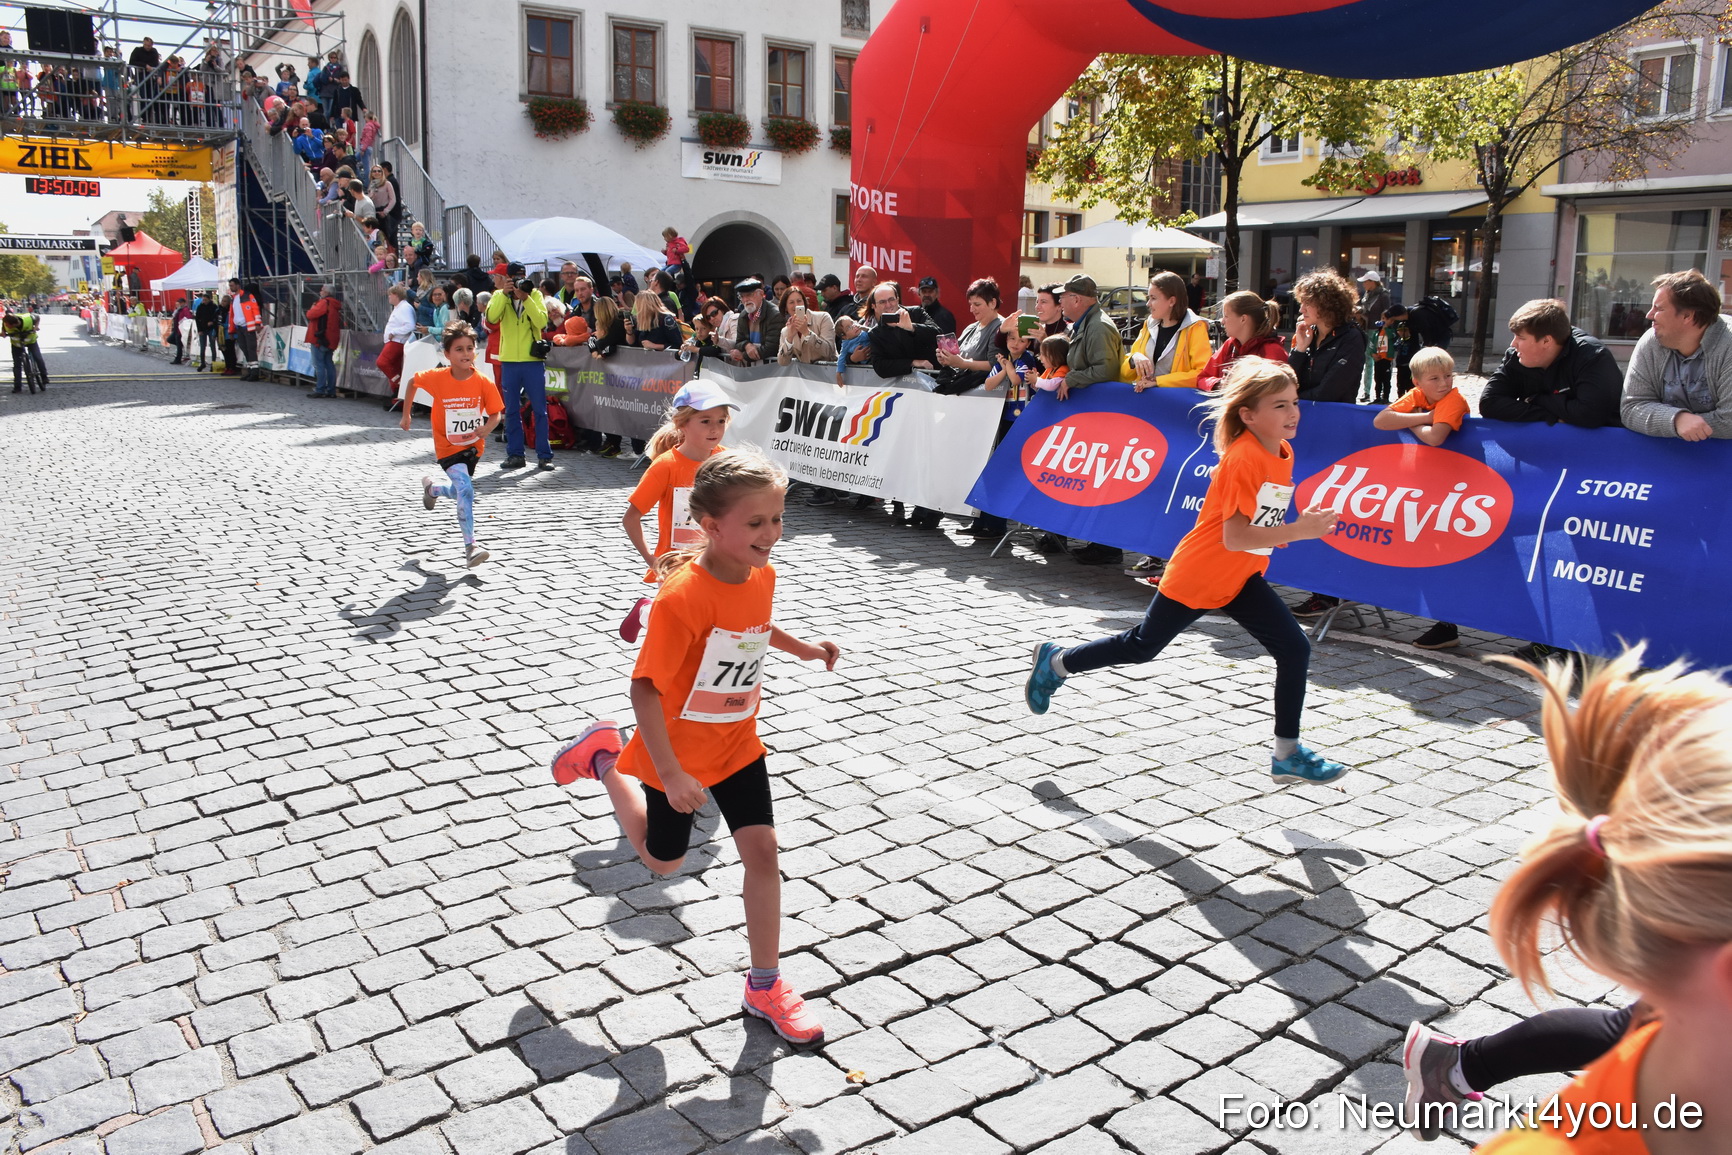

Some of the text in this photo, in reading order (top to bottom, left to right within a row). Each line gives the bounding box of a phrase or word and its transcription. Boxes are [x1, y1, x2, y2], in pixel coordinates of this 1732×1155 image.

[703, 151, 743, 167] swn
[15, 239, 86, 249] NEUMARKT.
[452, 418, 481, 432] 7043
[775, 397, 848, 442] swn
[813, 446, 870, 467] neumarkt
[1031, 425, 1156, 489] Hervis
[1037, 471, 1087, 492] SPORTS
[1576, 479, 1653, 501] STORE
[1309, 464, 1497, 543] Hervis
[1328, 520, 1393, 546] PORTS
[1563, 516, 1655, 548] ONLINE
[1552, 559, 1645, 593] MOBILE
[724, 697, 746, 707] Finia
